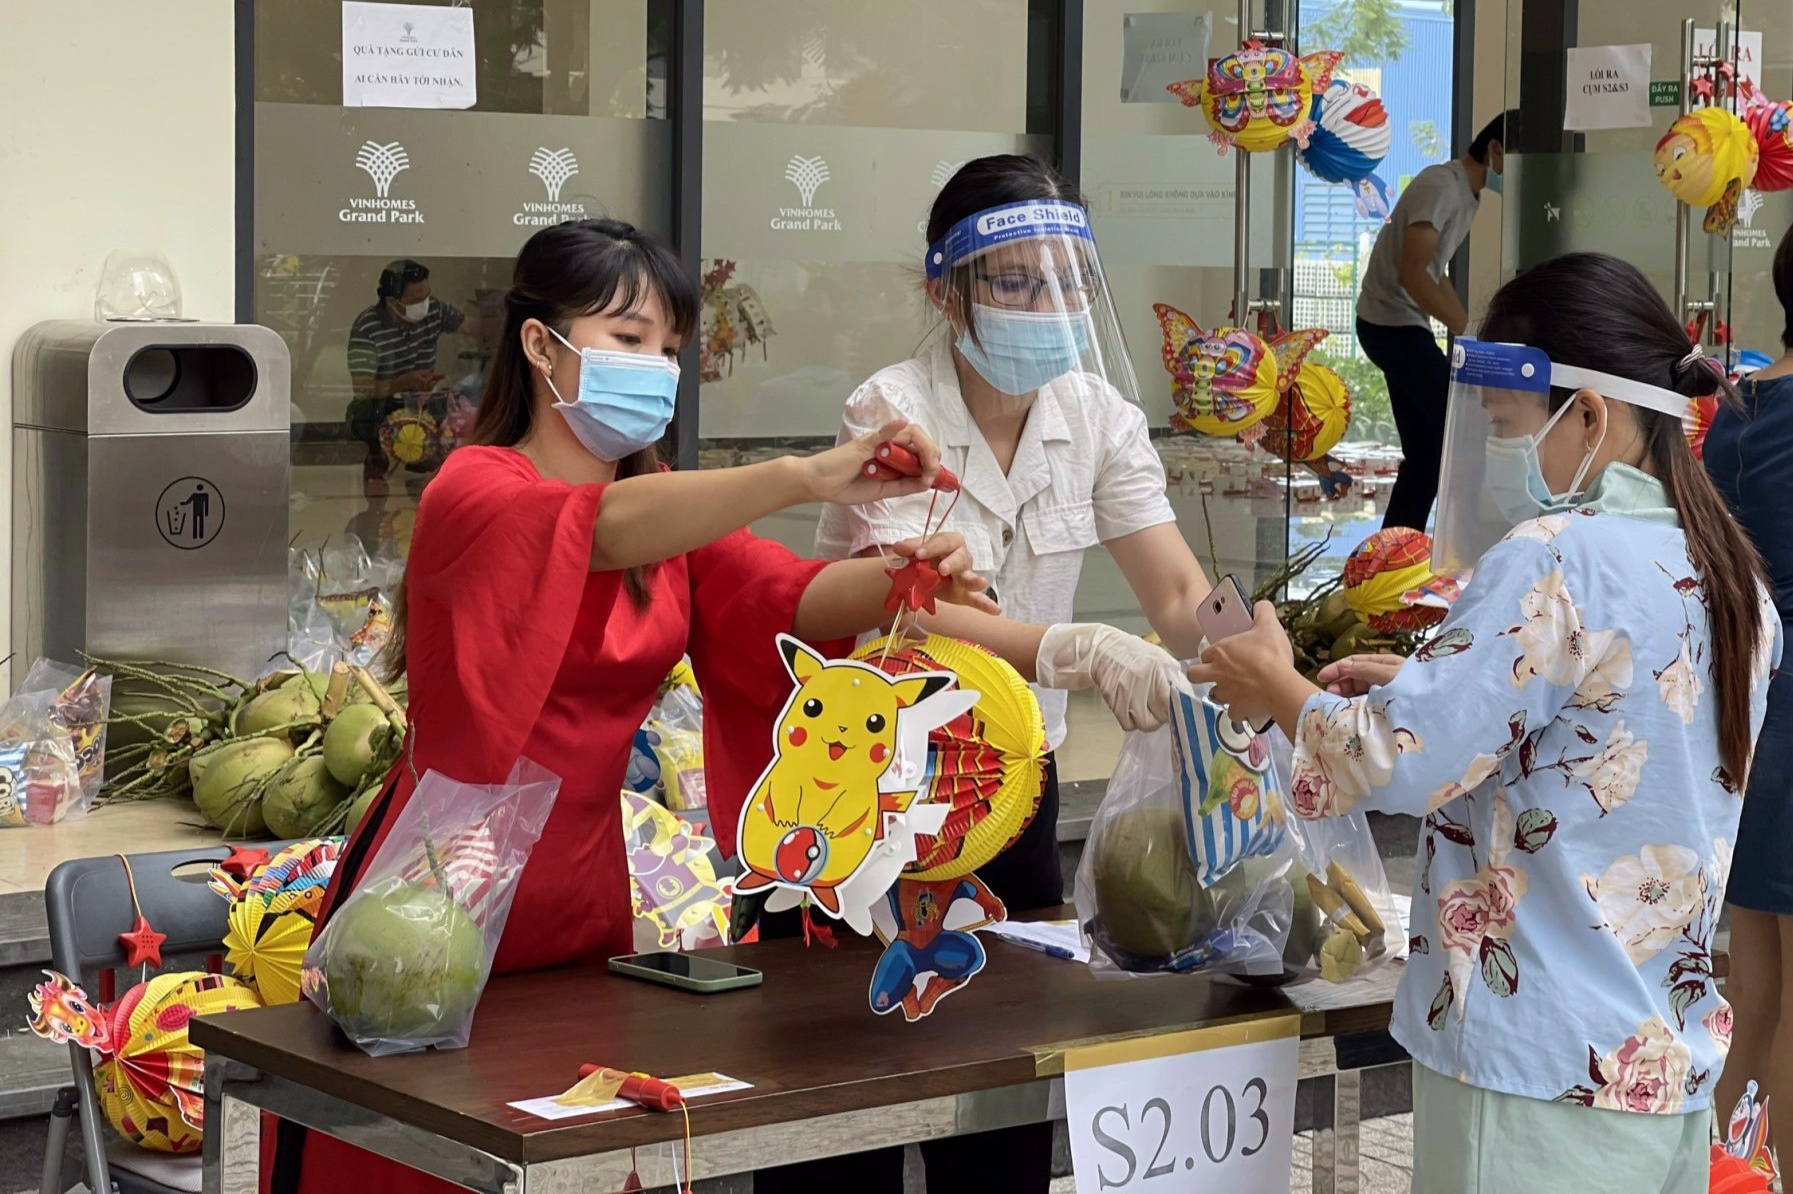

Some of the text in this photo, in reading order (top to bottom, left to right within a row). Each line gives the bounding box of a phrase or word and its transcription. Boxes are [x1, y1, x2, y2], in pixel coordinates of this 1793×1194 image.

[353, 44, 374, 56] QUÀ
[355, 75, 365, 83] AI
[1606, 69, 1619, 79] RA
[1582, 83, 1601, 96] CỤM
[1668, 83, 1679, 93] RA
[1655, 94, 1675, 103] PUSH
[350, 198, 416, 210] VINHOMES
[523, 202, 585, 213] VINHOMES
[339, 209, 424, 223] Grand Park
[779, 207, 835, 218] VINHOMES
[513, 213, 557, 225] Grand
[770, 217, 842, 231] Grand Park
[986, 208, 1081, 230] Face Shield
[1733, 228, 1767, 237] INHOMES
[1733, 237, 1771, 248] and Park
[1091, 1076, 1270, 1192] S2.03
